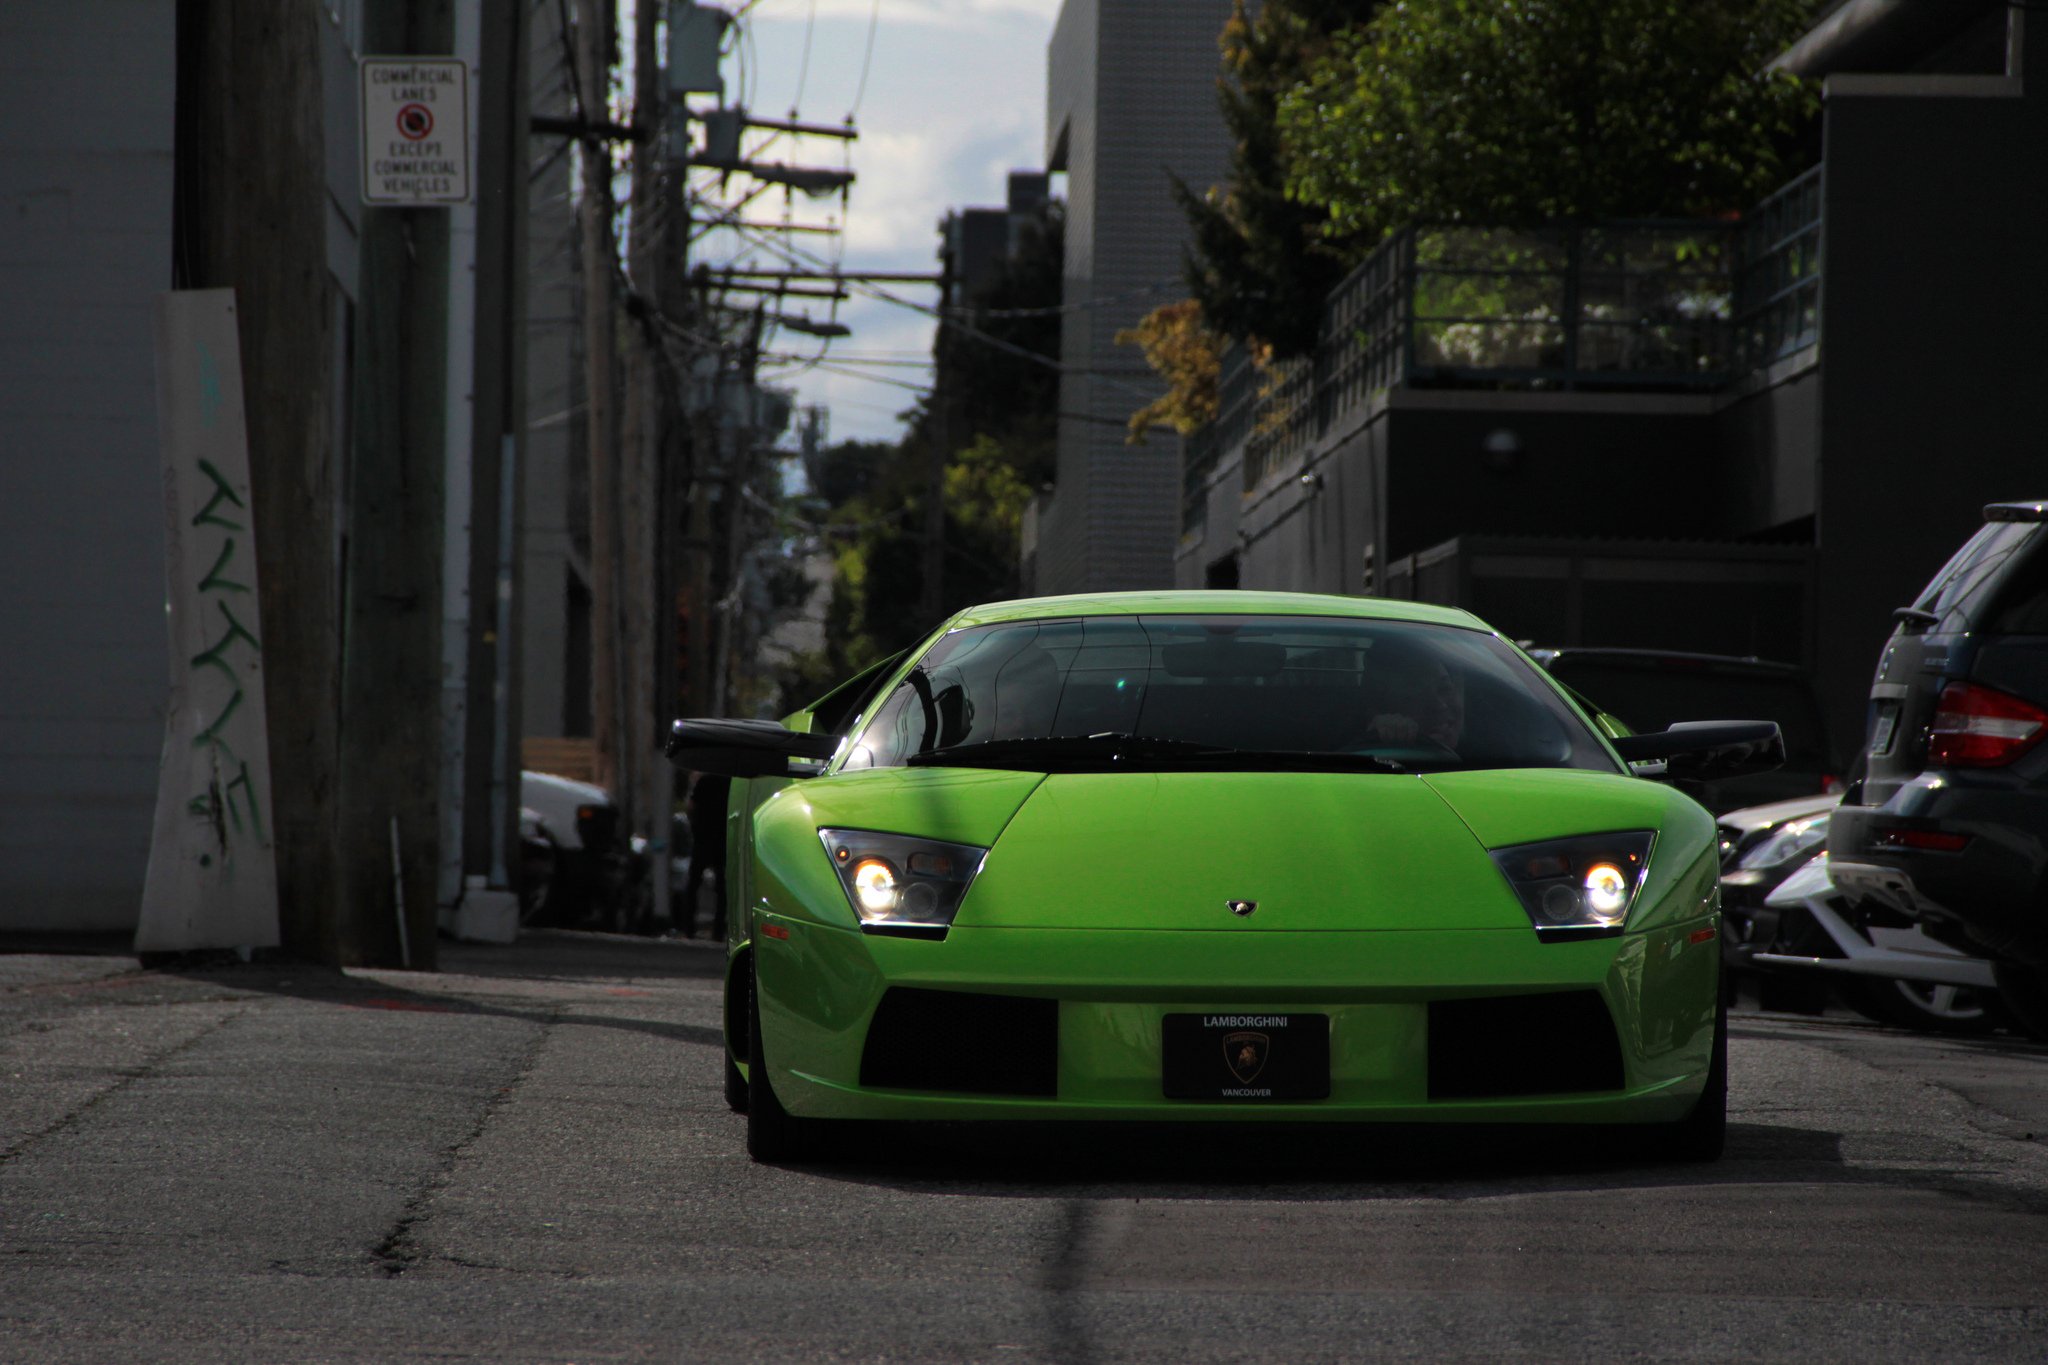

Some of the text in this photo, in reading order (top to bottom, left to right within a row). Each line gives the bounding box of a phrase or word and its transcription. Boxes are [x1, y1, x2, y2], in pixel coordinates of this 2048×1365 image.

[373, 68, 454, 84] COMMERCIAL
[392, 87, 437, 101] LANES
[390, 142, 441, 156] EXCEPT
[375, 160, 457, 175] COMMERCIAL
[383, 178, 450, 192] VEHICLES
[1203, 1016, 1288, 1027] LAMBORGHINI
[1222, 1088, 1272, 1097] VANCOUVER
